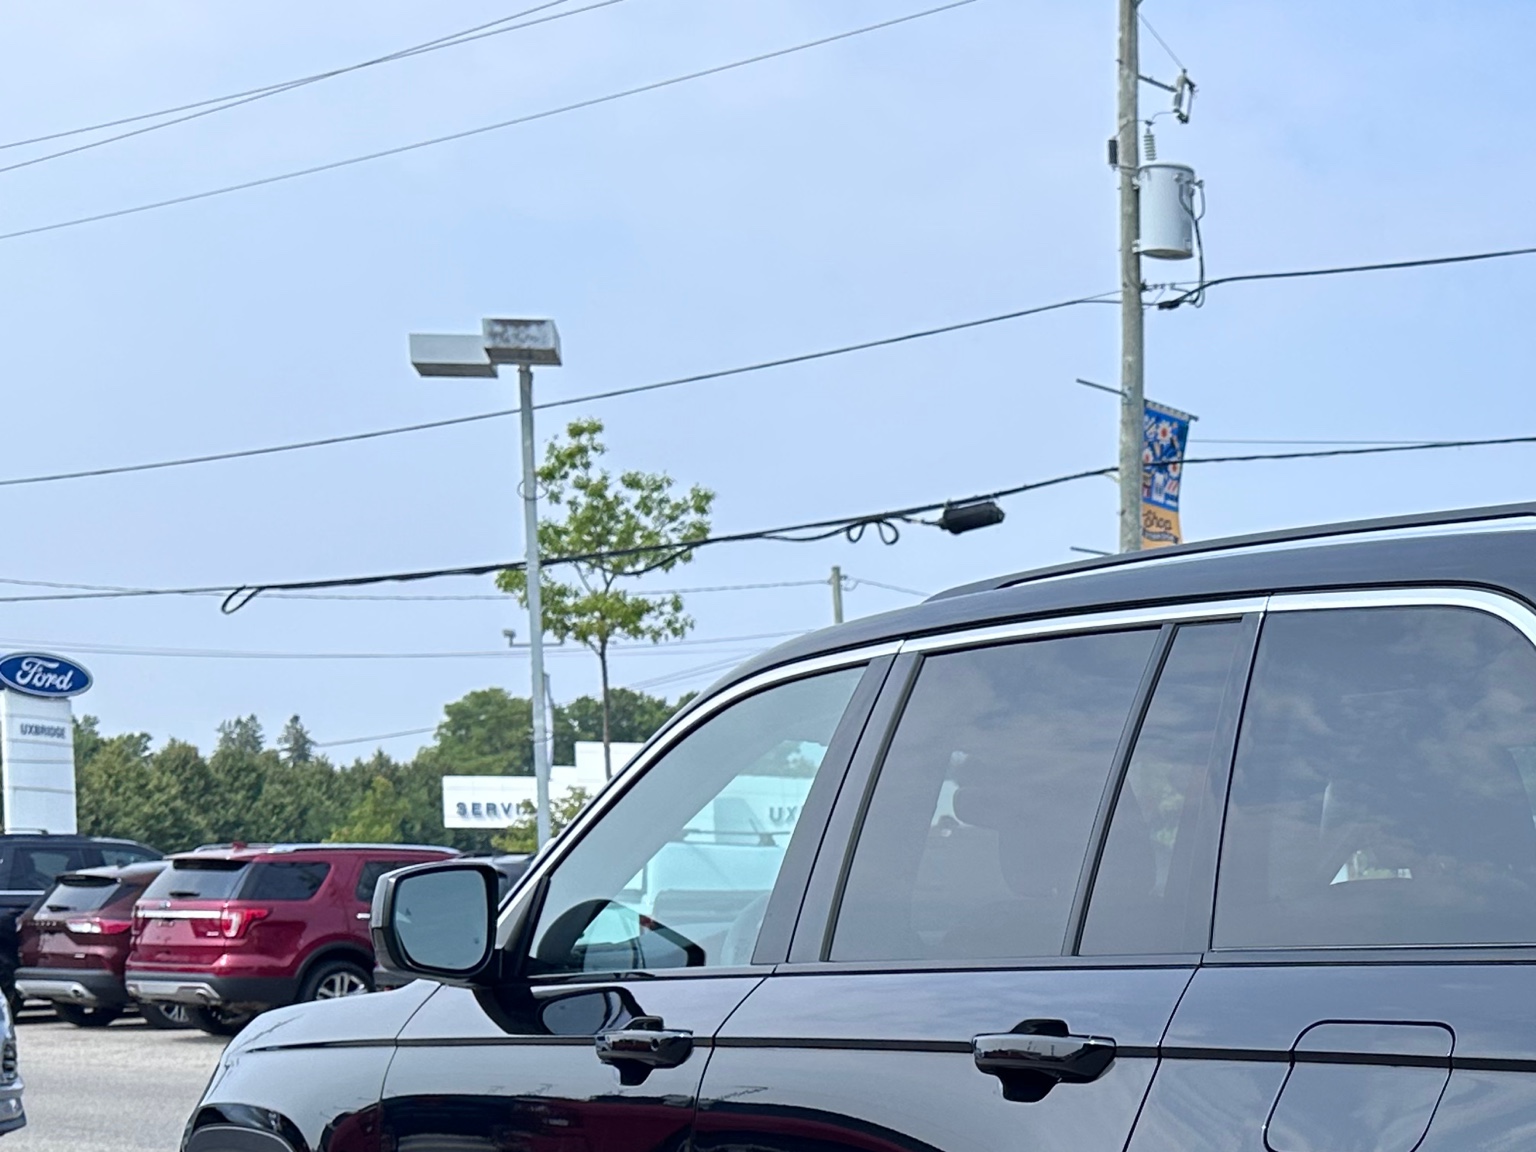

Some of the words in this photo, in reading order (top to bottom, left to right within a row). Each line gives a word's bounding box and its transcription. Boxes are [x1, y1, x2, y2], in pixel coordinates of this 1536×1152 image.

[15, 657, 74, 691] Ford
[20, 723, 66, 739] UXBRIDGE
[456, 802, 522, 817] SERVI
